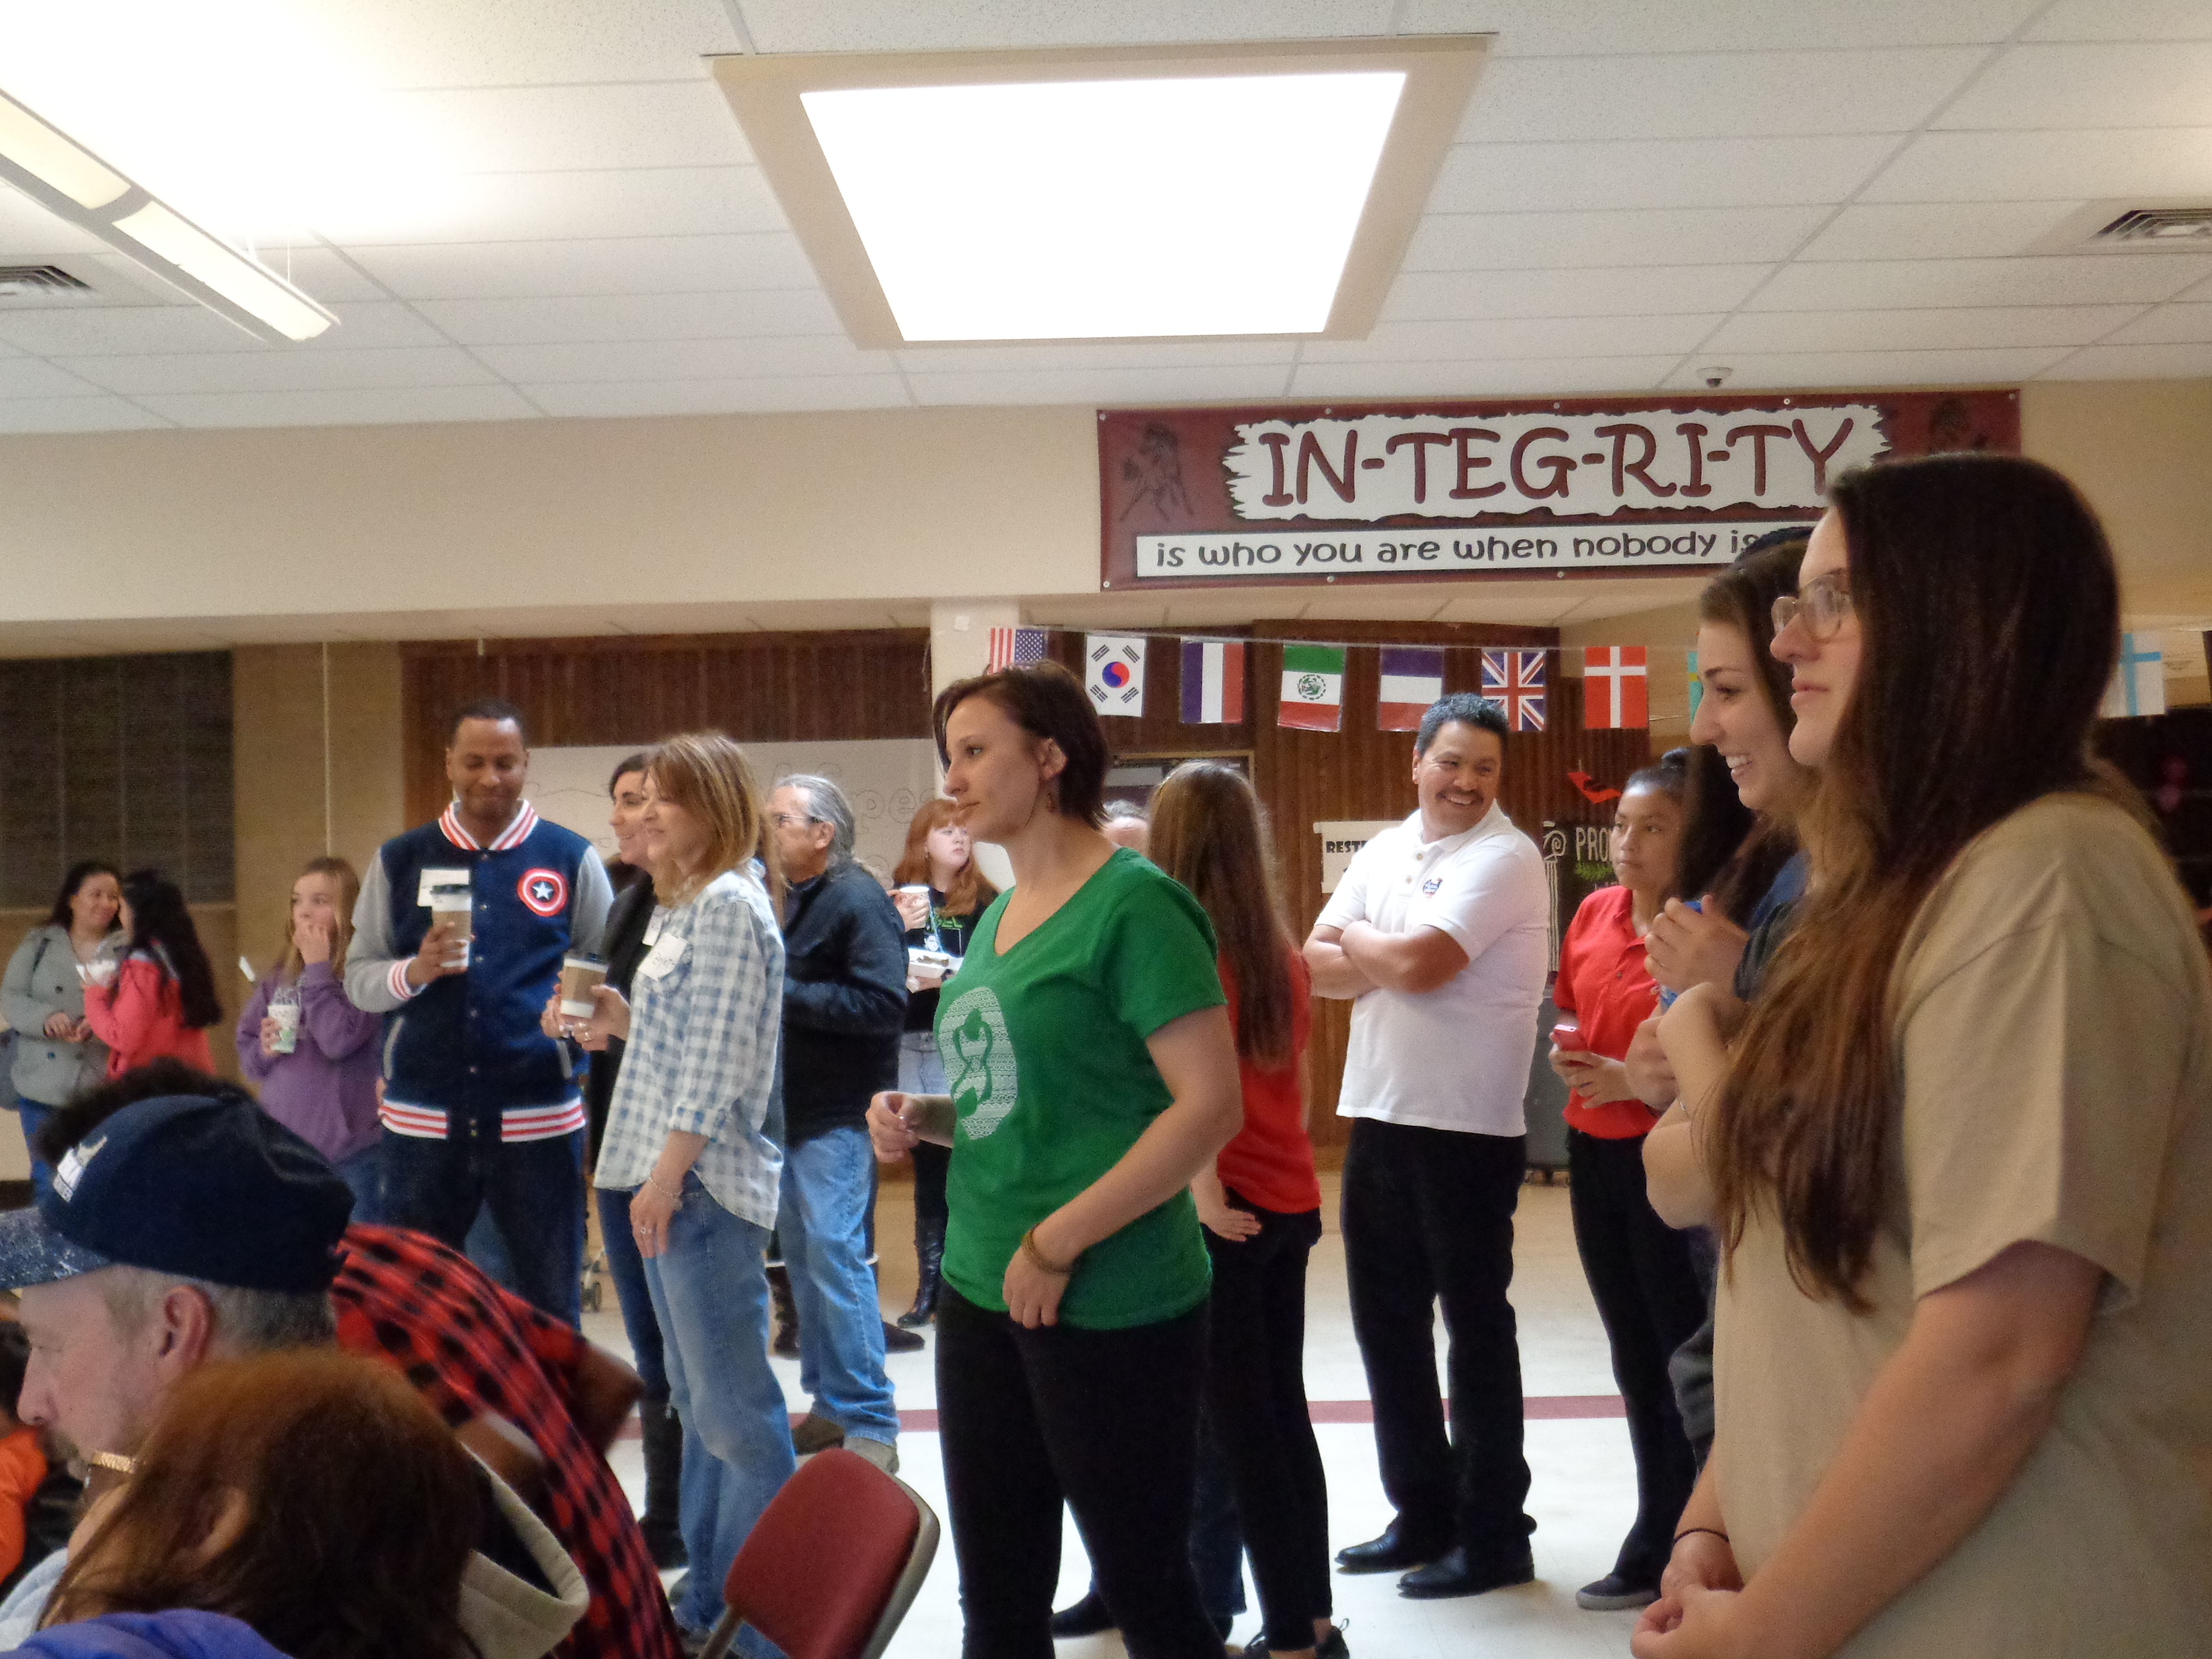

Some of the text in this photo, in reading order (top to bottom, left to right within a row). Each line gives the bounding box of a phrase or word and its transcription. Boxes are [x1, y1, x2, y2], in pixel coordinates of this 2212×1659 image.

[1258, 418, 1854, 507] IN-TEG-RI-TY
[1157, 542, 1185, 567] is
[1198, 541, 1282, 567] who
[1294, 543, 1362, 566] you
[1377, 541, 1440, 564] are
[1453, 536, 1557, 561] when
[1573, 531, 1717, 558] nobody
[1576, 827, 1611, 862] PRO
